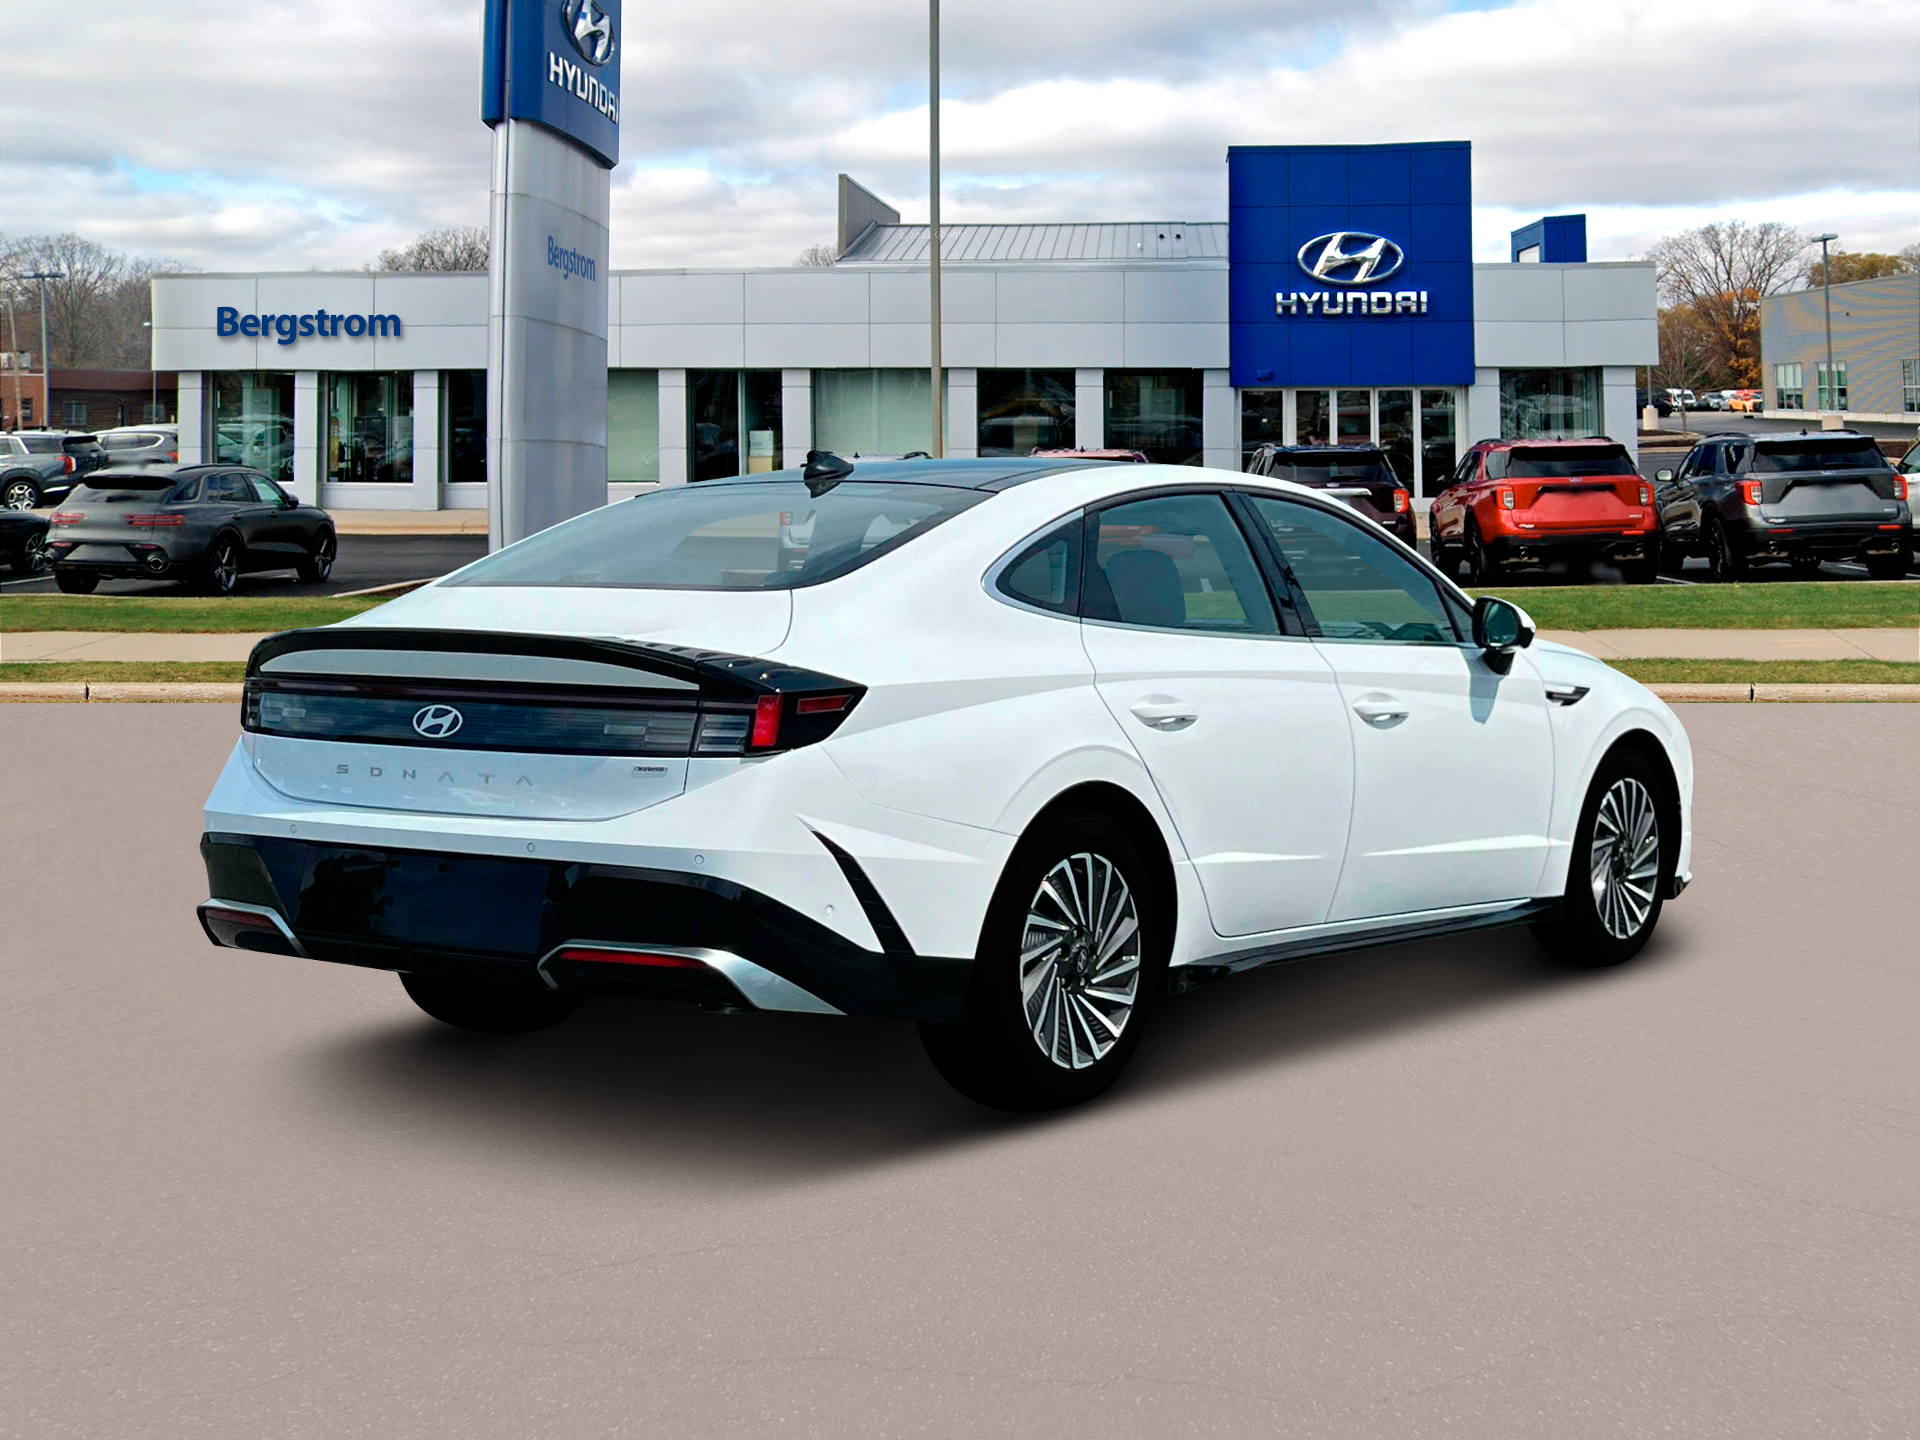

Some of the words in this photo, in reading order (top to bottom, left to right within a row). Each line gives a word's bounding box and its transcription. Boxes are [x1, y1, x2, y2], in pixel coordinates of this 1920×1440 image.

[549, 51, 618, 125] HYUNDAI
[547, 235, 596, 282] Bergstrom
[1275, 291, 1428, 315] HYUNDAI
[216, 306, 402, 346] Bergstrom
[336, 764, 533, 787] SONATA
